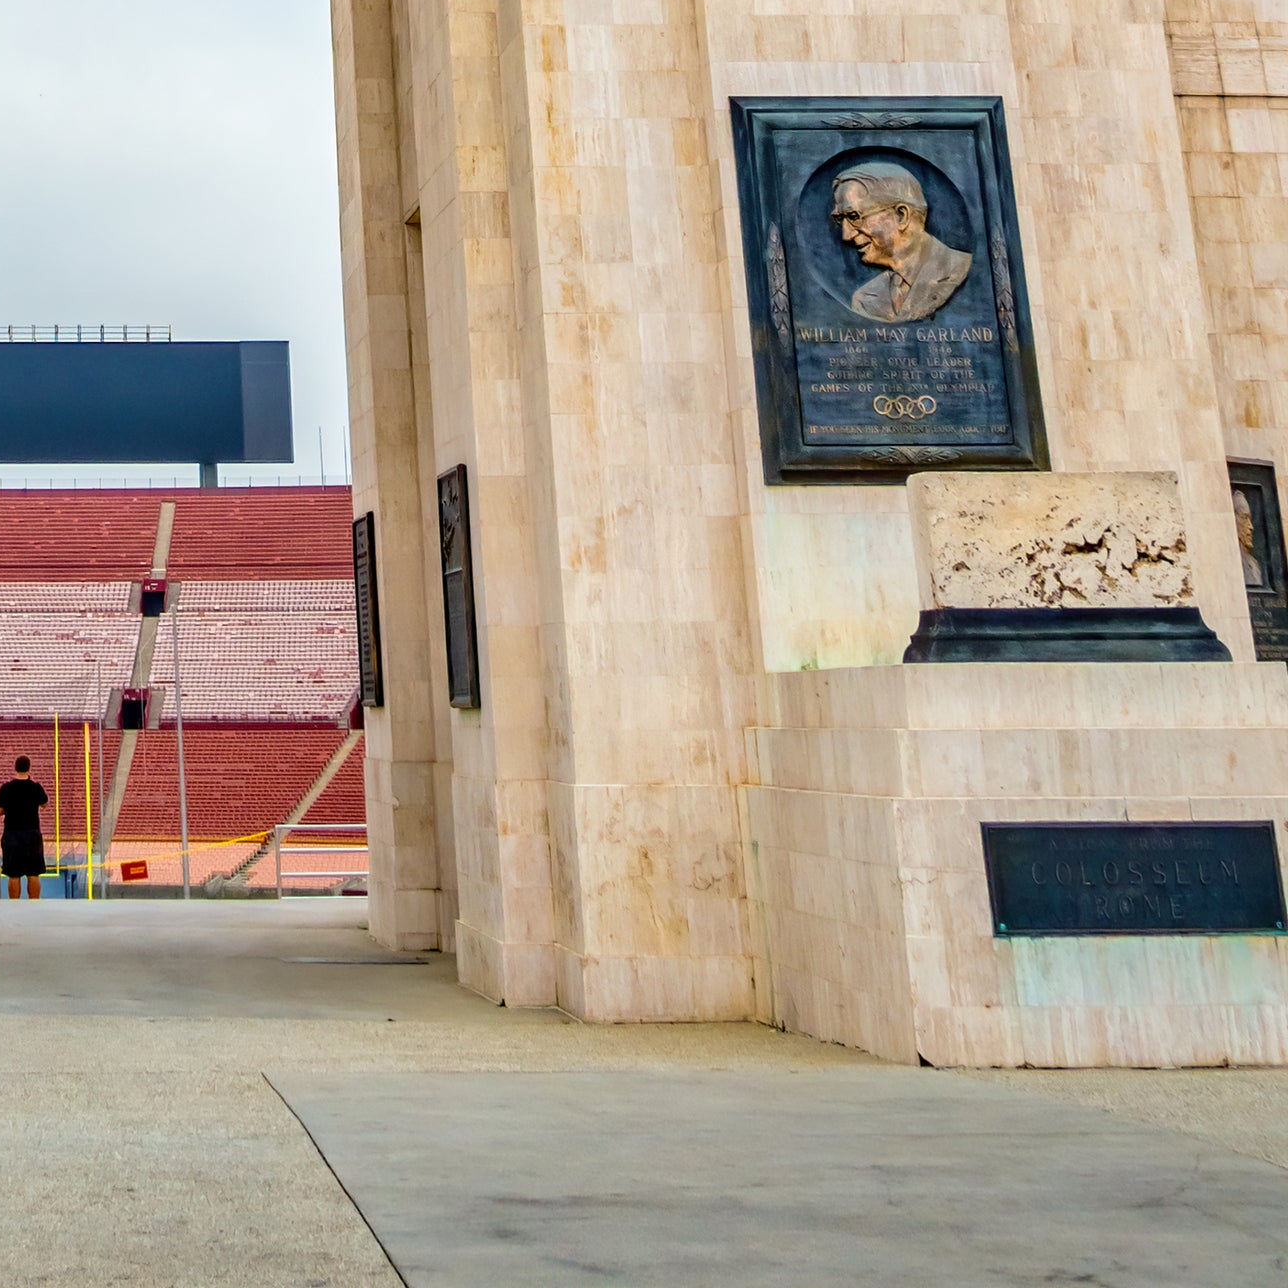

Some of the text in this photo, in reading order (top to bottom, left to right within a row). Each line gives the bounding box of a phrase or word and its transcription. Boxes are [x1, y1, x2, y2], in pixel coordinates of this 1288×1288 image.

[799, 327, 993, 343] WILLIAM MAY GARLAND
[926, 357, 972, 367] LEADER
[930, 370, 945, 380] OF
[953, 370, 976, 380] THE
[811, 383, 850, 393] GAMES
[858, 383, 874, 393] OF
[880, 383, 905, 393] THE
[1031, 859, 1240, 886] COLOSSEUM
